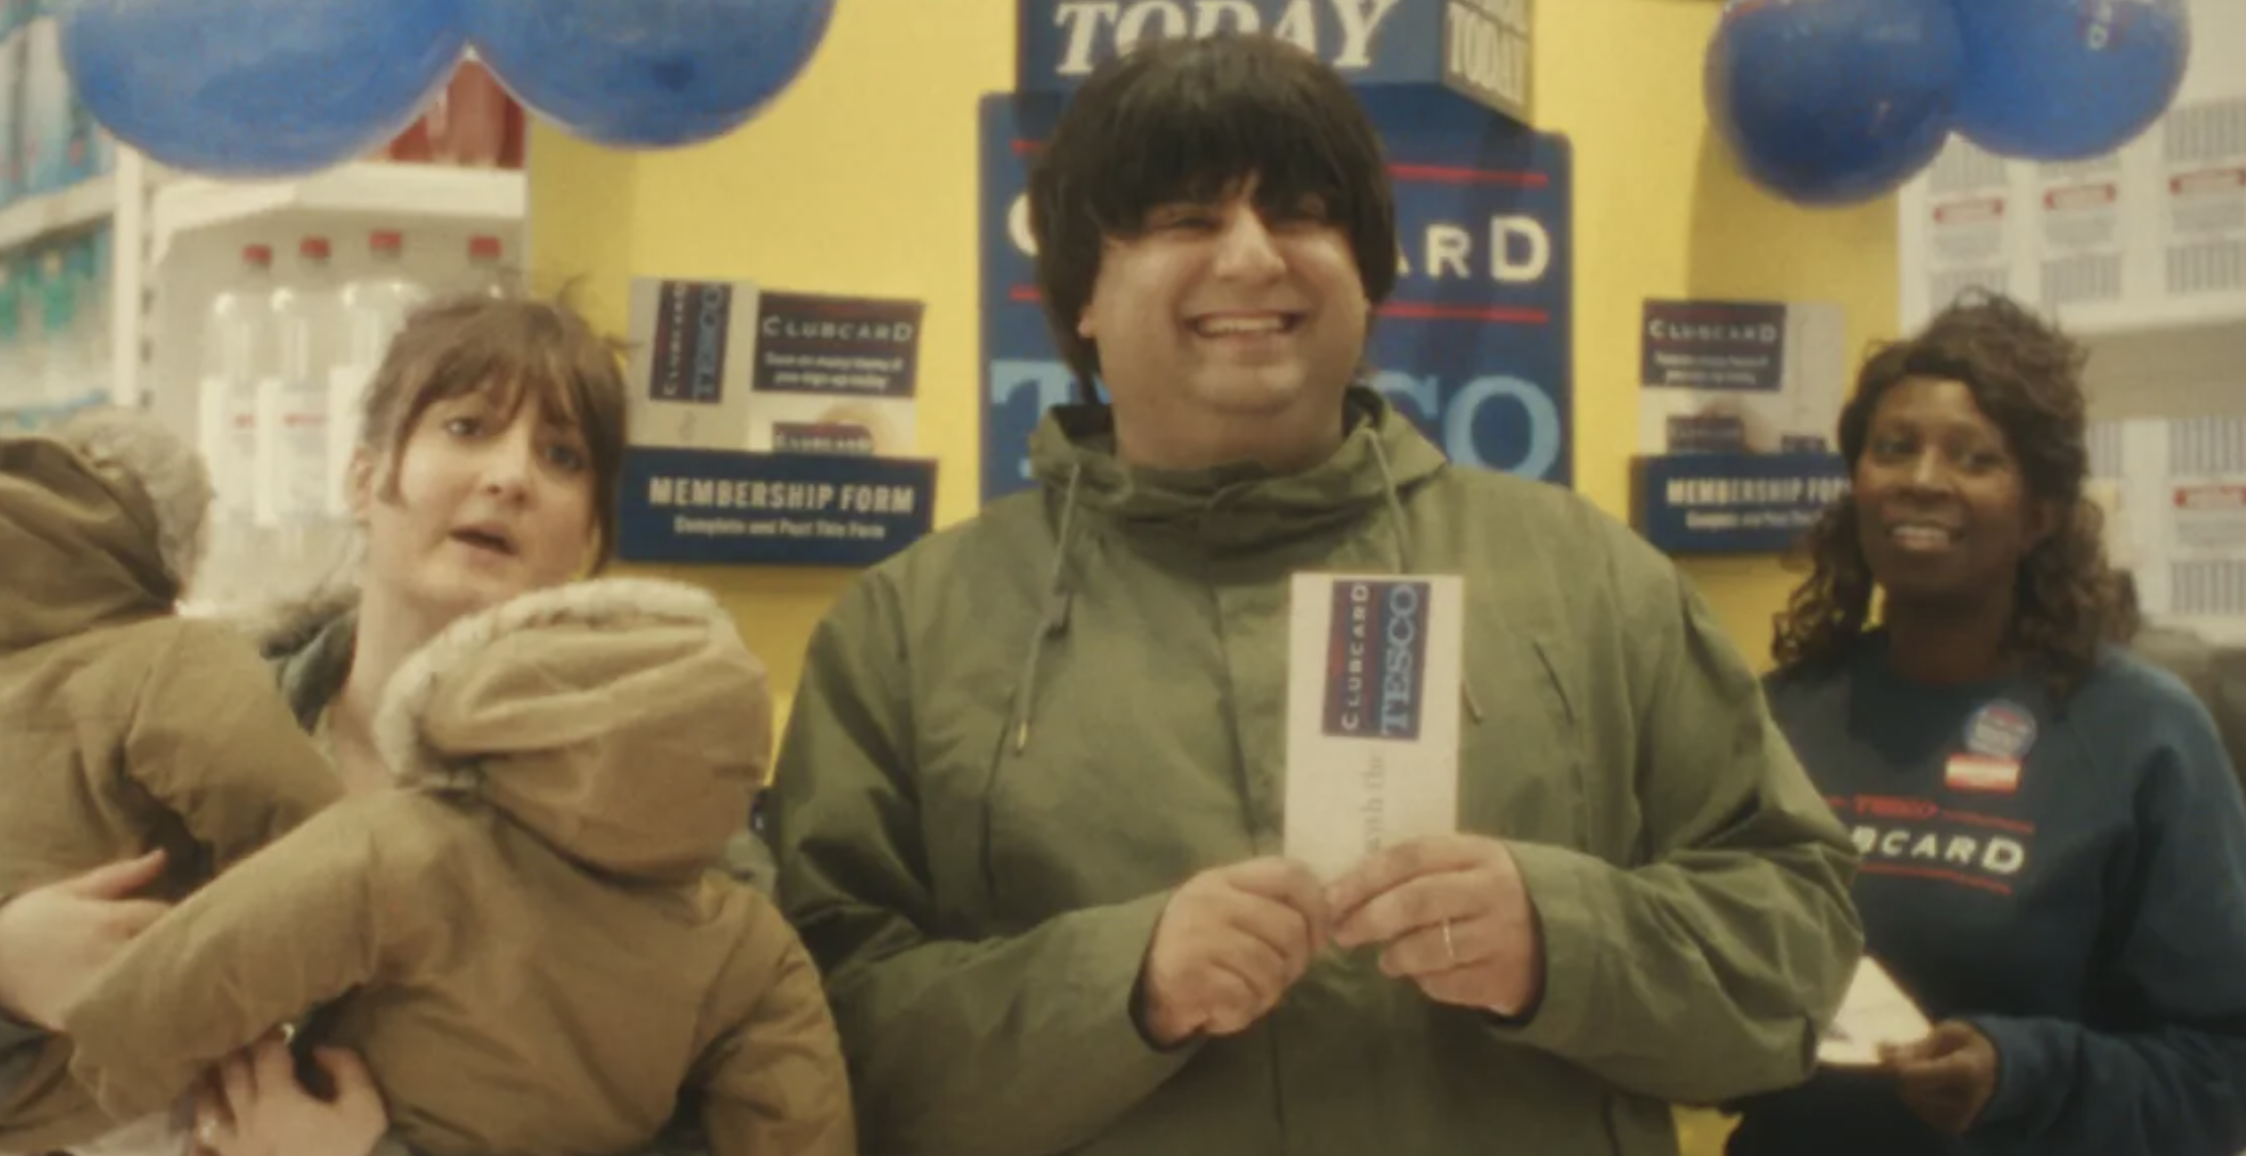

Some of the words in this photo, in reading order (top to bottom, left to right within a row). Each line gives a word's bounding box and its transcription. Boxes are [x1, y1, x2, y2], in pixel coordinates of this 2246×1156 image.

[762, 315, 913, 343] CLUBCARD
[648, 475, 834, 510] MEMBERSHIP
[839, 483, 915, 514] FORM
[1340, 582, 1371, 731] CLUBCARD
[1380, 583, 1419, 737] TESCO
[1851, 825, 2025, 875] BCARD
